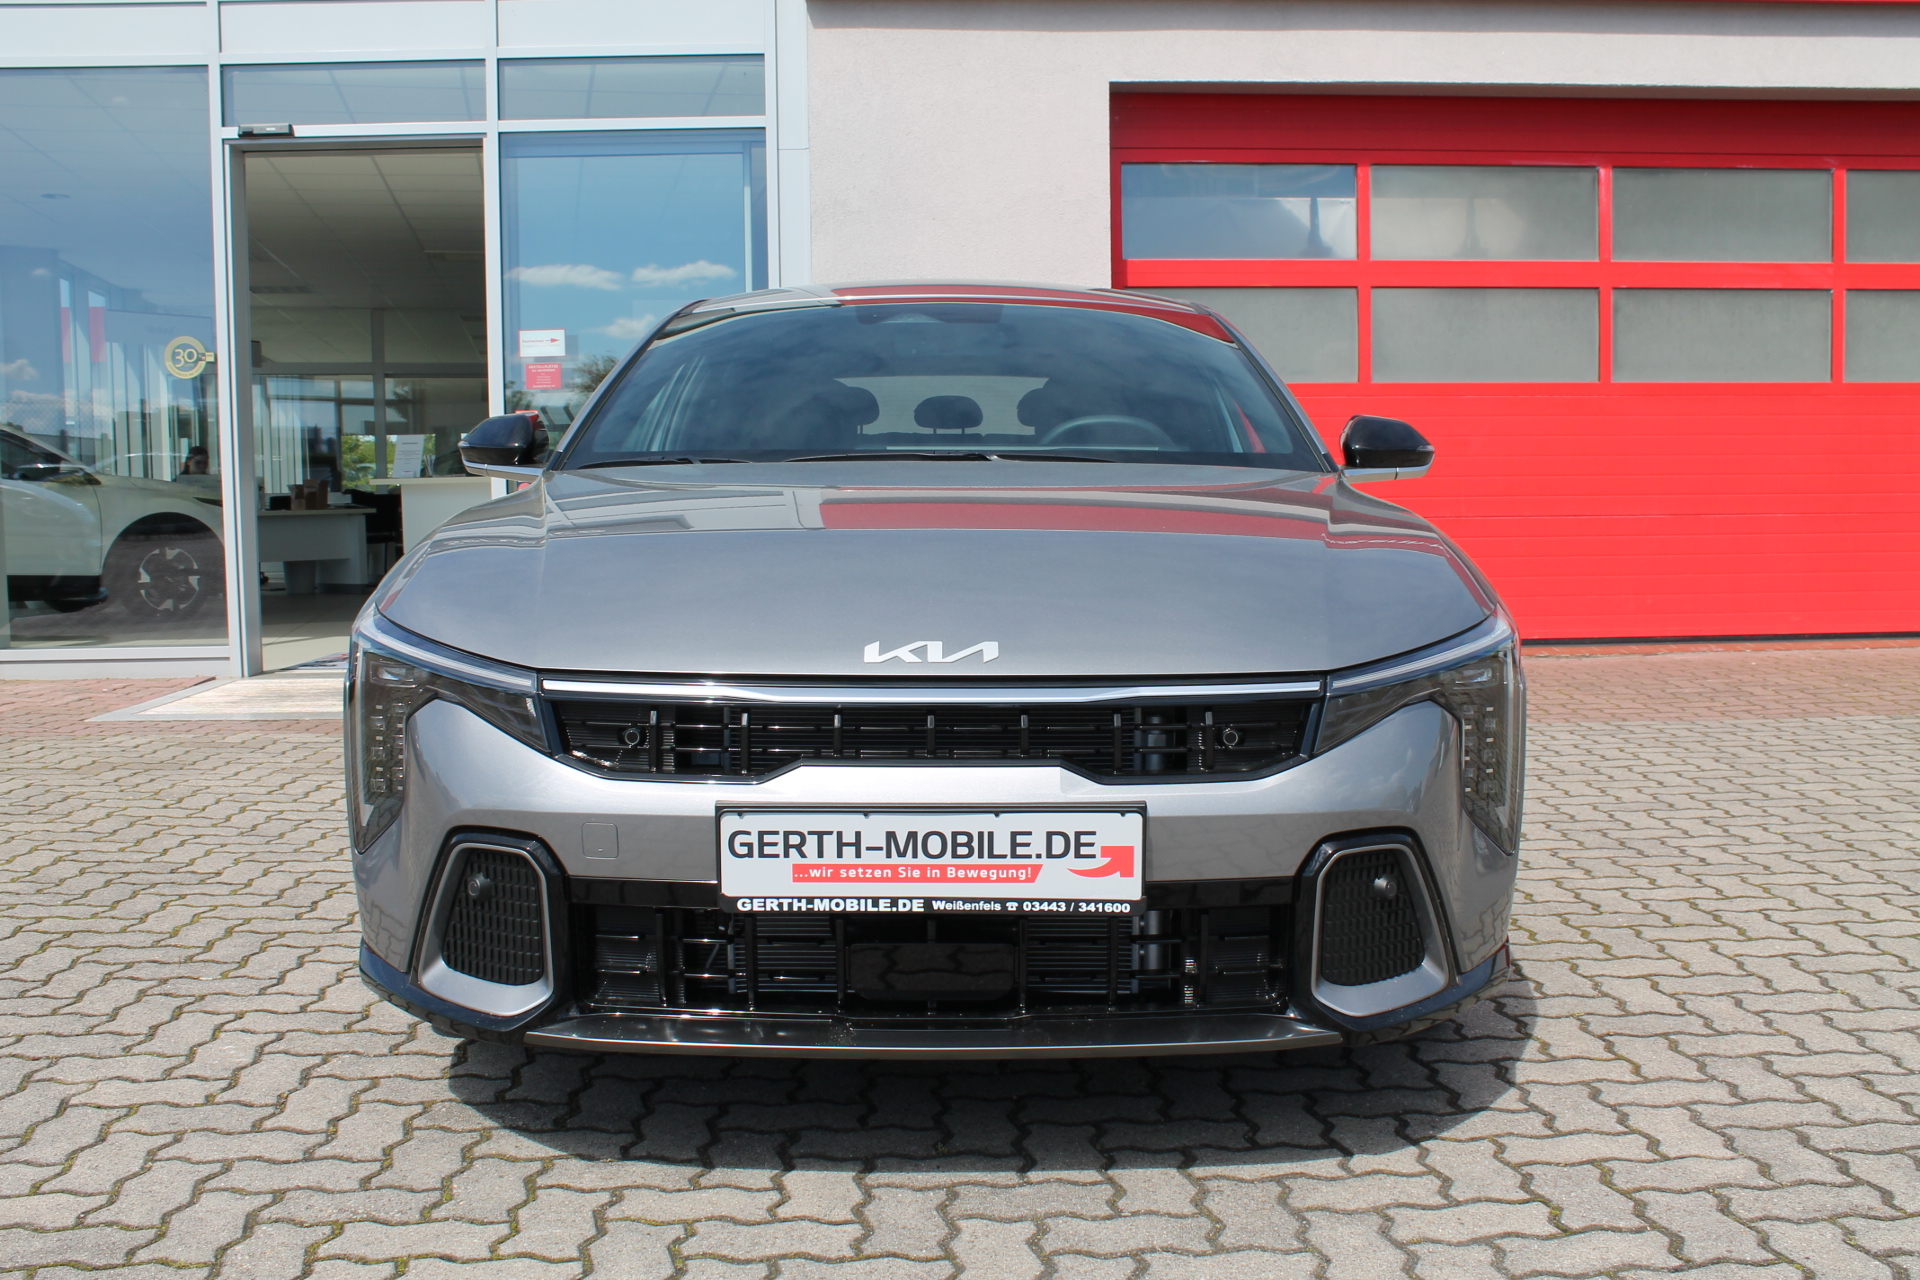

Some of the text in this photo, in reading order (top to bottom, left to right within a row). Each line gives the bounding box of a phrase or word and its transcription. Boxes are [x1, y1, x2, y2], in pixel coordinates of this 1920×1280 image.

[174, 348, 198, 367] 30
[864, 641, 999, 663] KIA
[728, 830, 1097, 859] GERTH-MOBILE.DE
[839, 868, 892, 878] setzen
[898, 866, 921, 878] Sie
[927, 866, 940, 878] in
[947, 866, 1032, 881] Bewegung!
[736, 898, 925, 912] GERTH-MOBILE.DE
[932, 900, 1001, 911] Weißenfels
[1023, 901, 1066, 912] 03443
[1078, 902, 1131, 913] 341600
